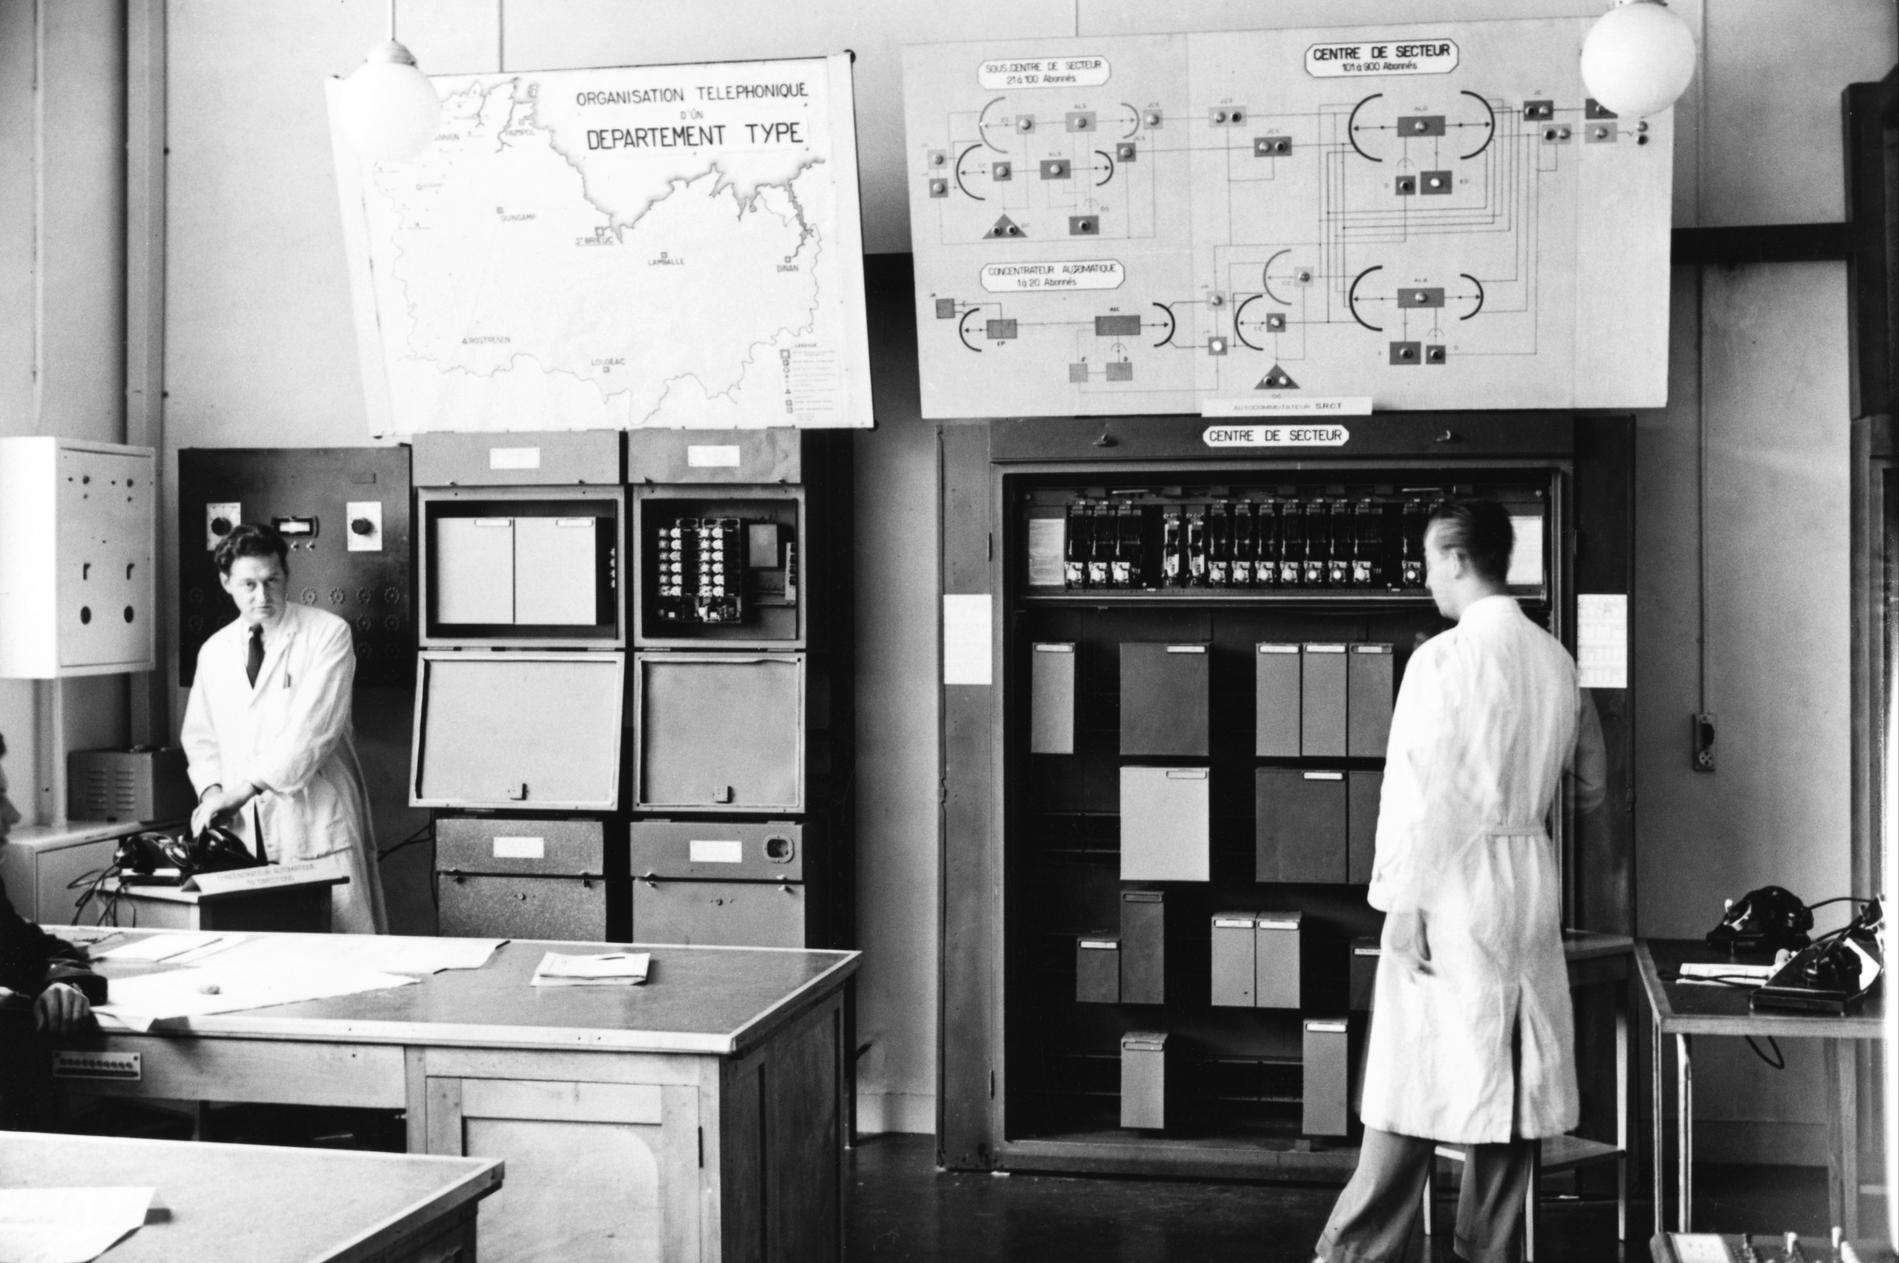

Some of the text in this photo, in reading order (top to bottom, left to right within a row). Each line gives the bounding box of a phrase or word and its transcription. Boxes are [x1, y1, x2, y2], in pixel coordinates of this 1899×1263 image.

[1313, 43, 1451, 61] CENTRE DE SECTEUR
[1047, 61, 1058, 71] DE
[1065, 60, 1102, 70] SECTEUR
[1342, 62, 1355, 72] 101
[1363, 62, 1380, 71] 900
[1382, 60, 1417, 70] Abonnés
[1025, 75, 1039, 84] 100
[1043, 72, 1077, 83] Abonnés
[576, 82, 809, 106] ORGANISATION TELEPHONIQUE
[587, 122, 805, 151] DEPARTEMENT TYPE
[988, 264, 1117, 276] CONCENTRATEUR AUTOMATIQUE
[1029, 279, 1040, 287] 20
[1044, 277, 1077, 287] Abonnés
[1209, 429, 1343, 442] CENTRE DE SECTEUR
